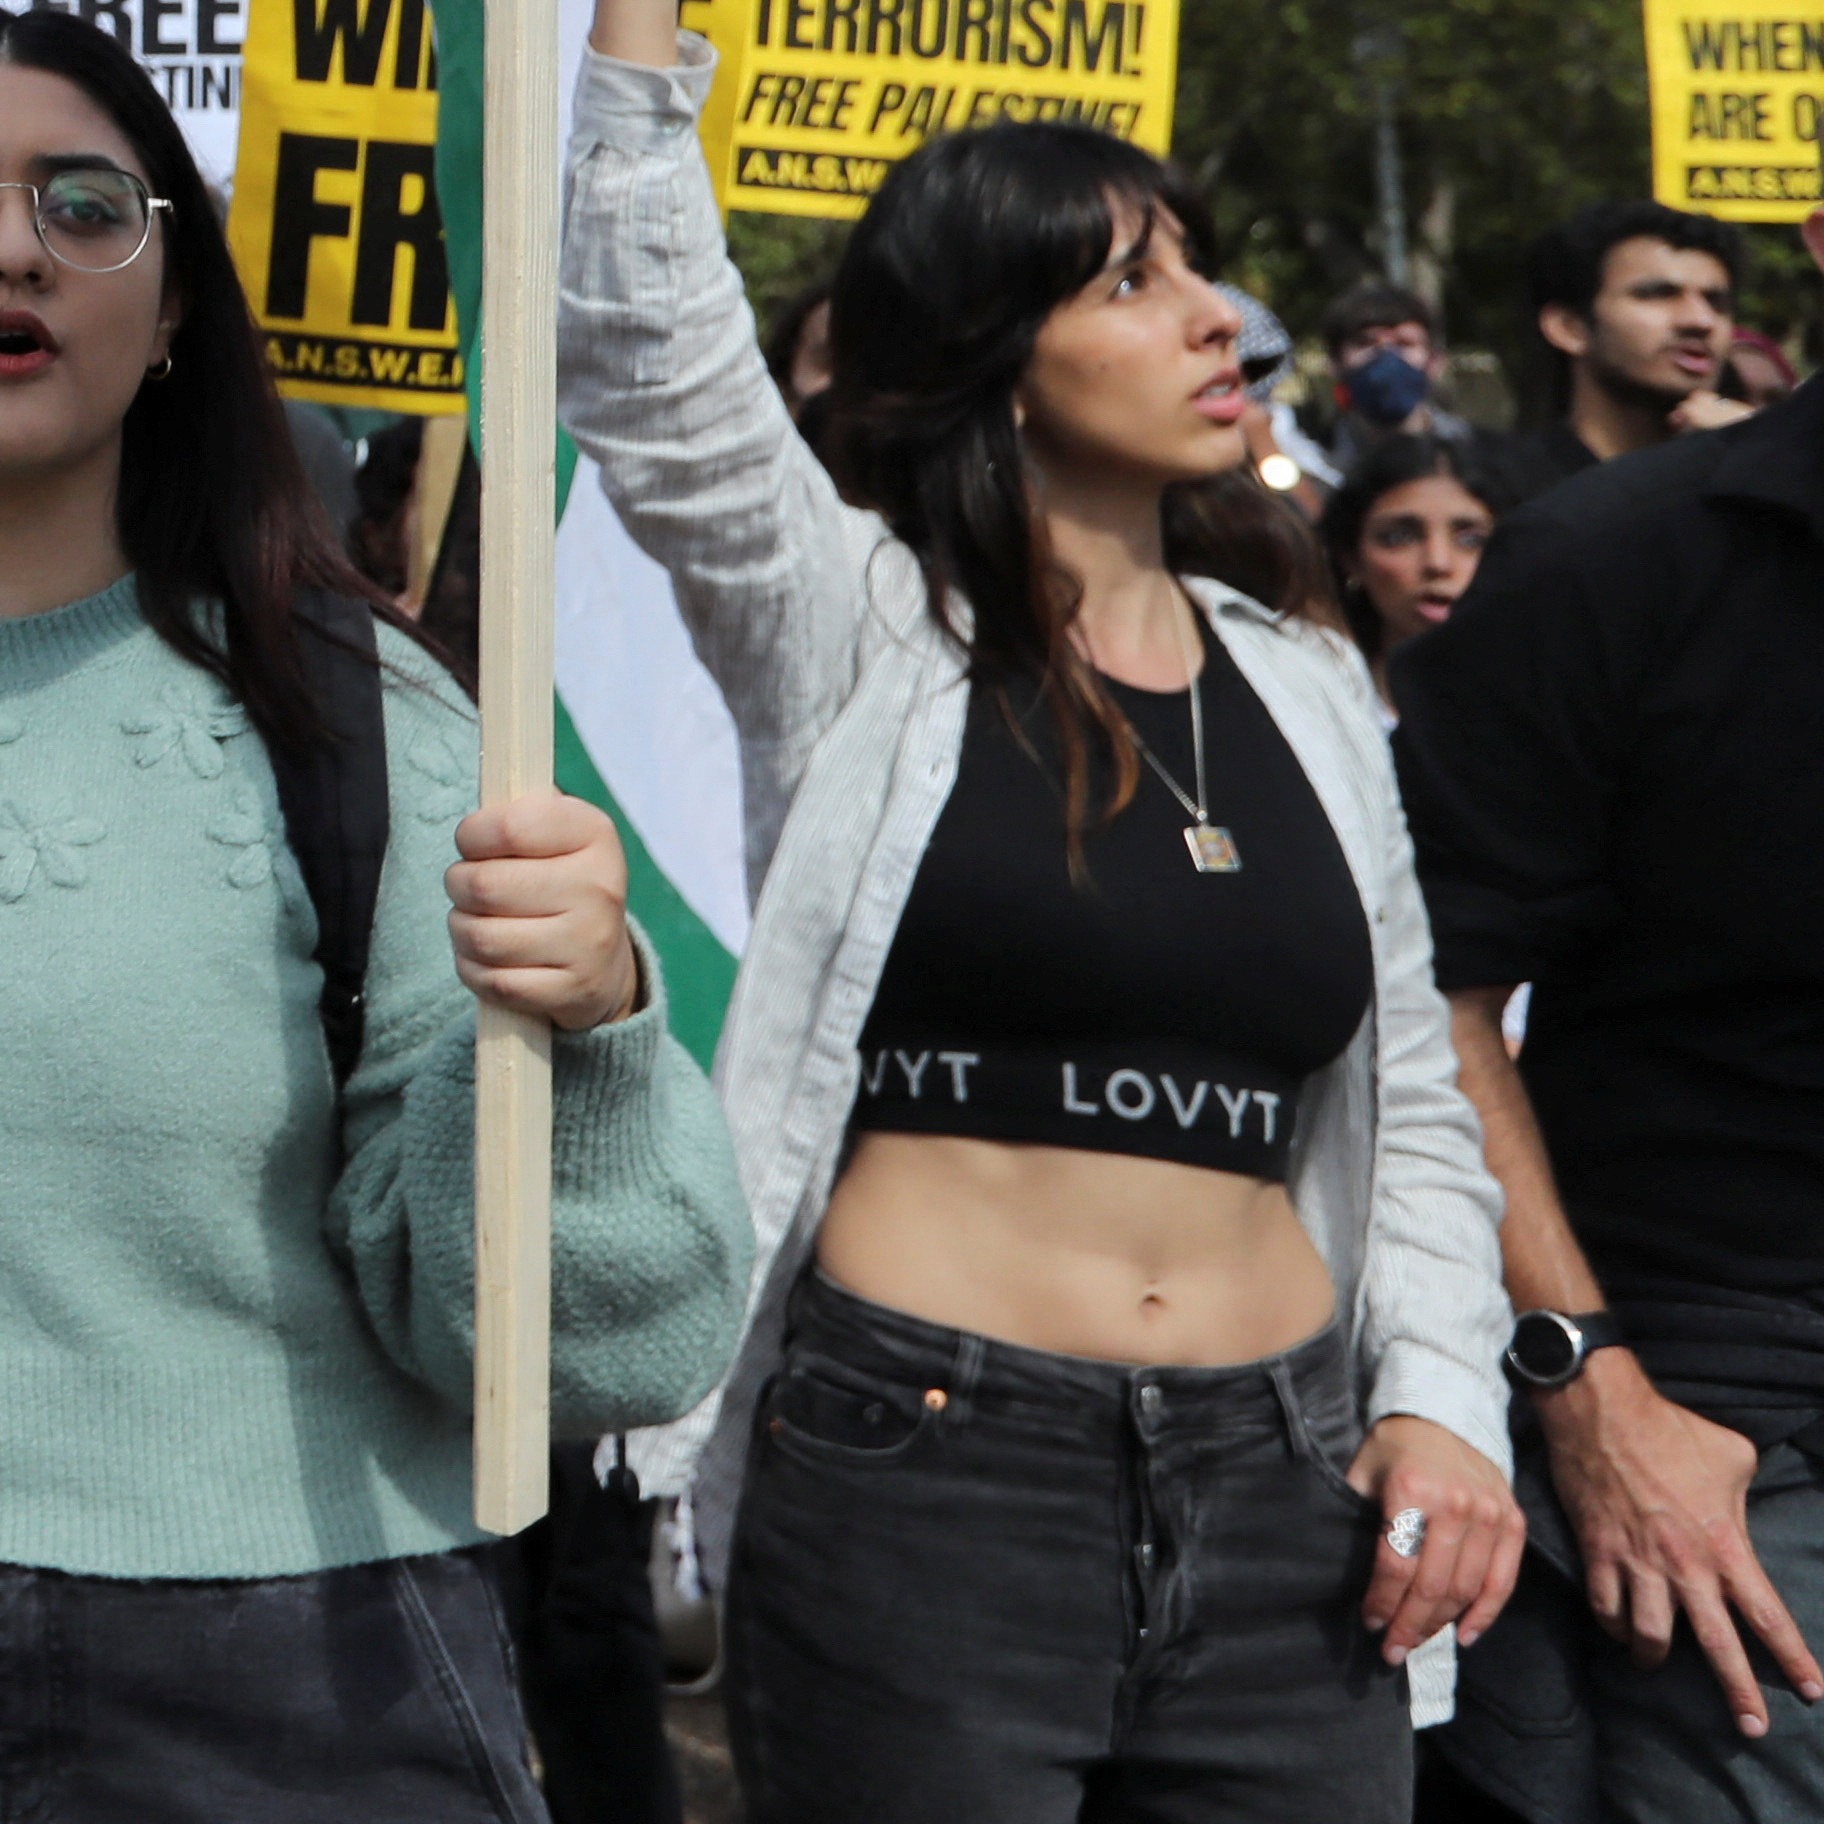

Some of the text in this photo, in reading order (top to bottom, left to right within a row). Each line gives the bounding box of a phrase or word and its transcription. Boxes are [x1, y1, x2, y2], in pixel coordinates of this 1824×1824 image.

[743, 72, 861, 131] FREE
[1687, 91, 1773, 142] ARE
[1061, 1061, 1281, 1144] LOVYT
